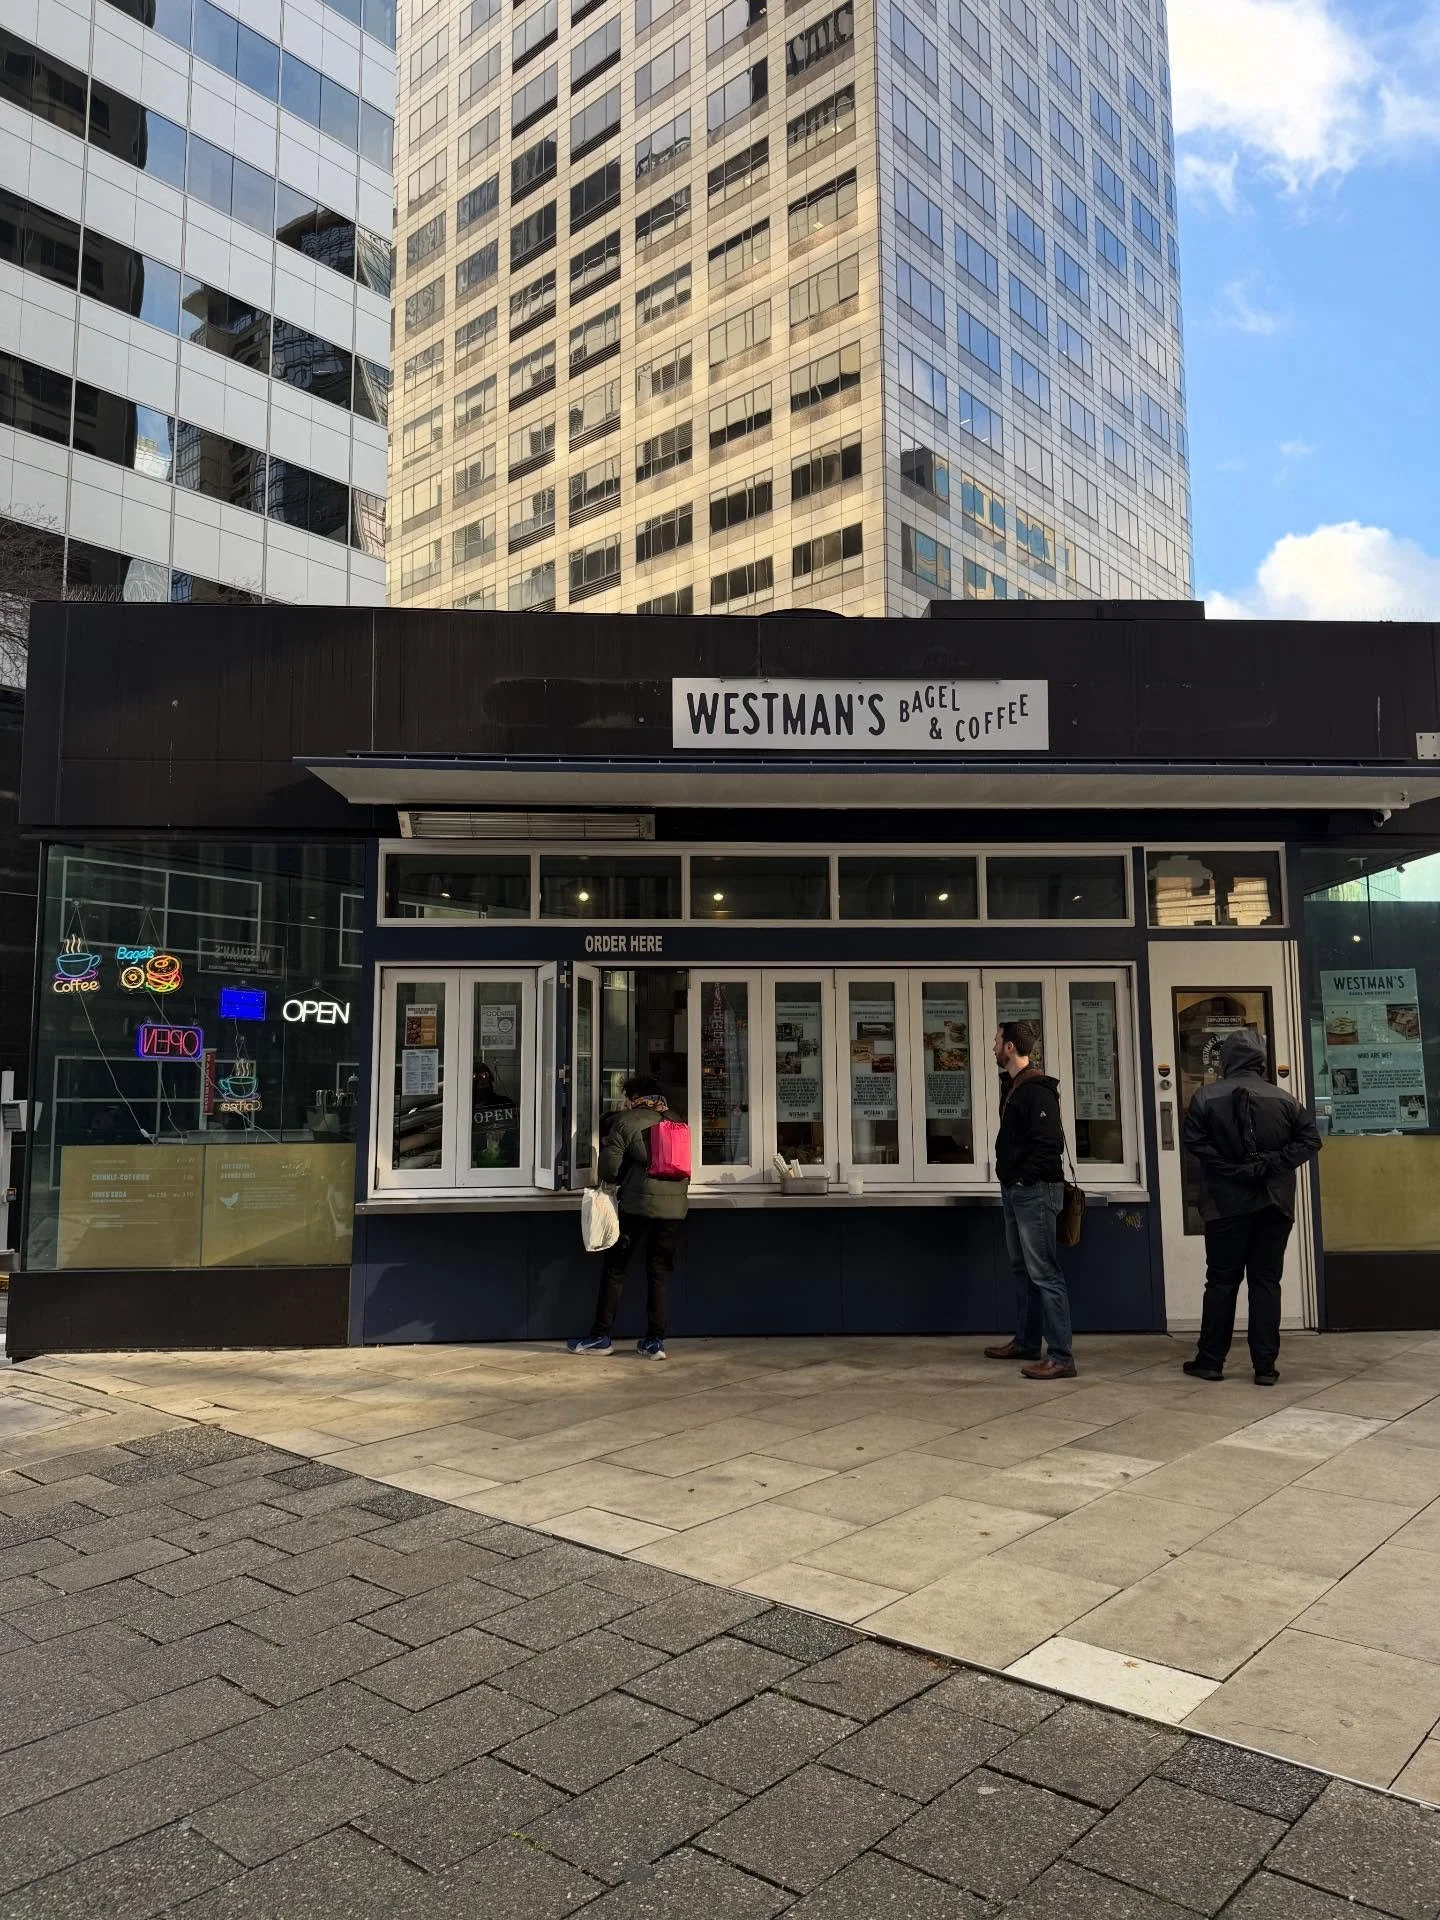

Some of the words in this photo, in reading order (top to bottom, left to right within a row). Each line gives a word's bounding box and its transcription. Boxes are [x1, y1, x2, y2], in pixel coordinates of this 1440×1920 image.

[899, 685, 961, 724] BAGEL
[686, 692, 886, 737] WESTMAN'S
[929, 717, 943, 740] &
[955, 693, 1030, 743] COFFEE
[585, 935, 627, 953] ORDER
[630, 935, 663, 953] HERE
[116, 946, 156, 965] Bagels
[53, 979, 100, 993] Coffee
[1333, 975, 1406, 991] WESTMAN'S
[283, 1000, 351, 1025] OPEN
[474, 1108, 513, 1124] OPEN
